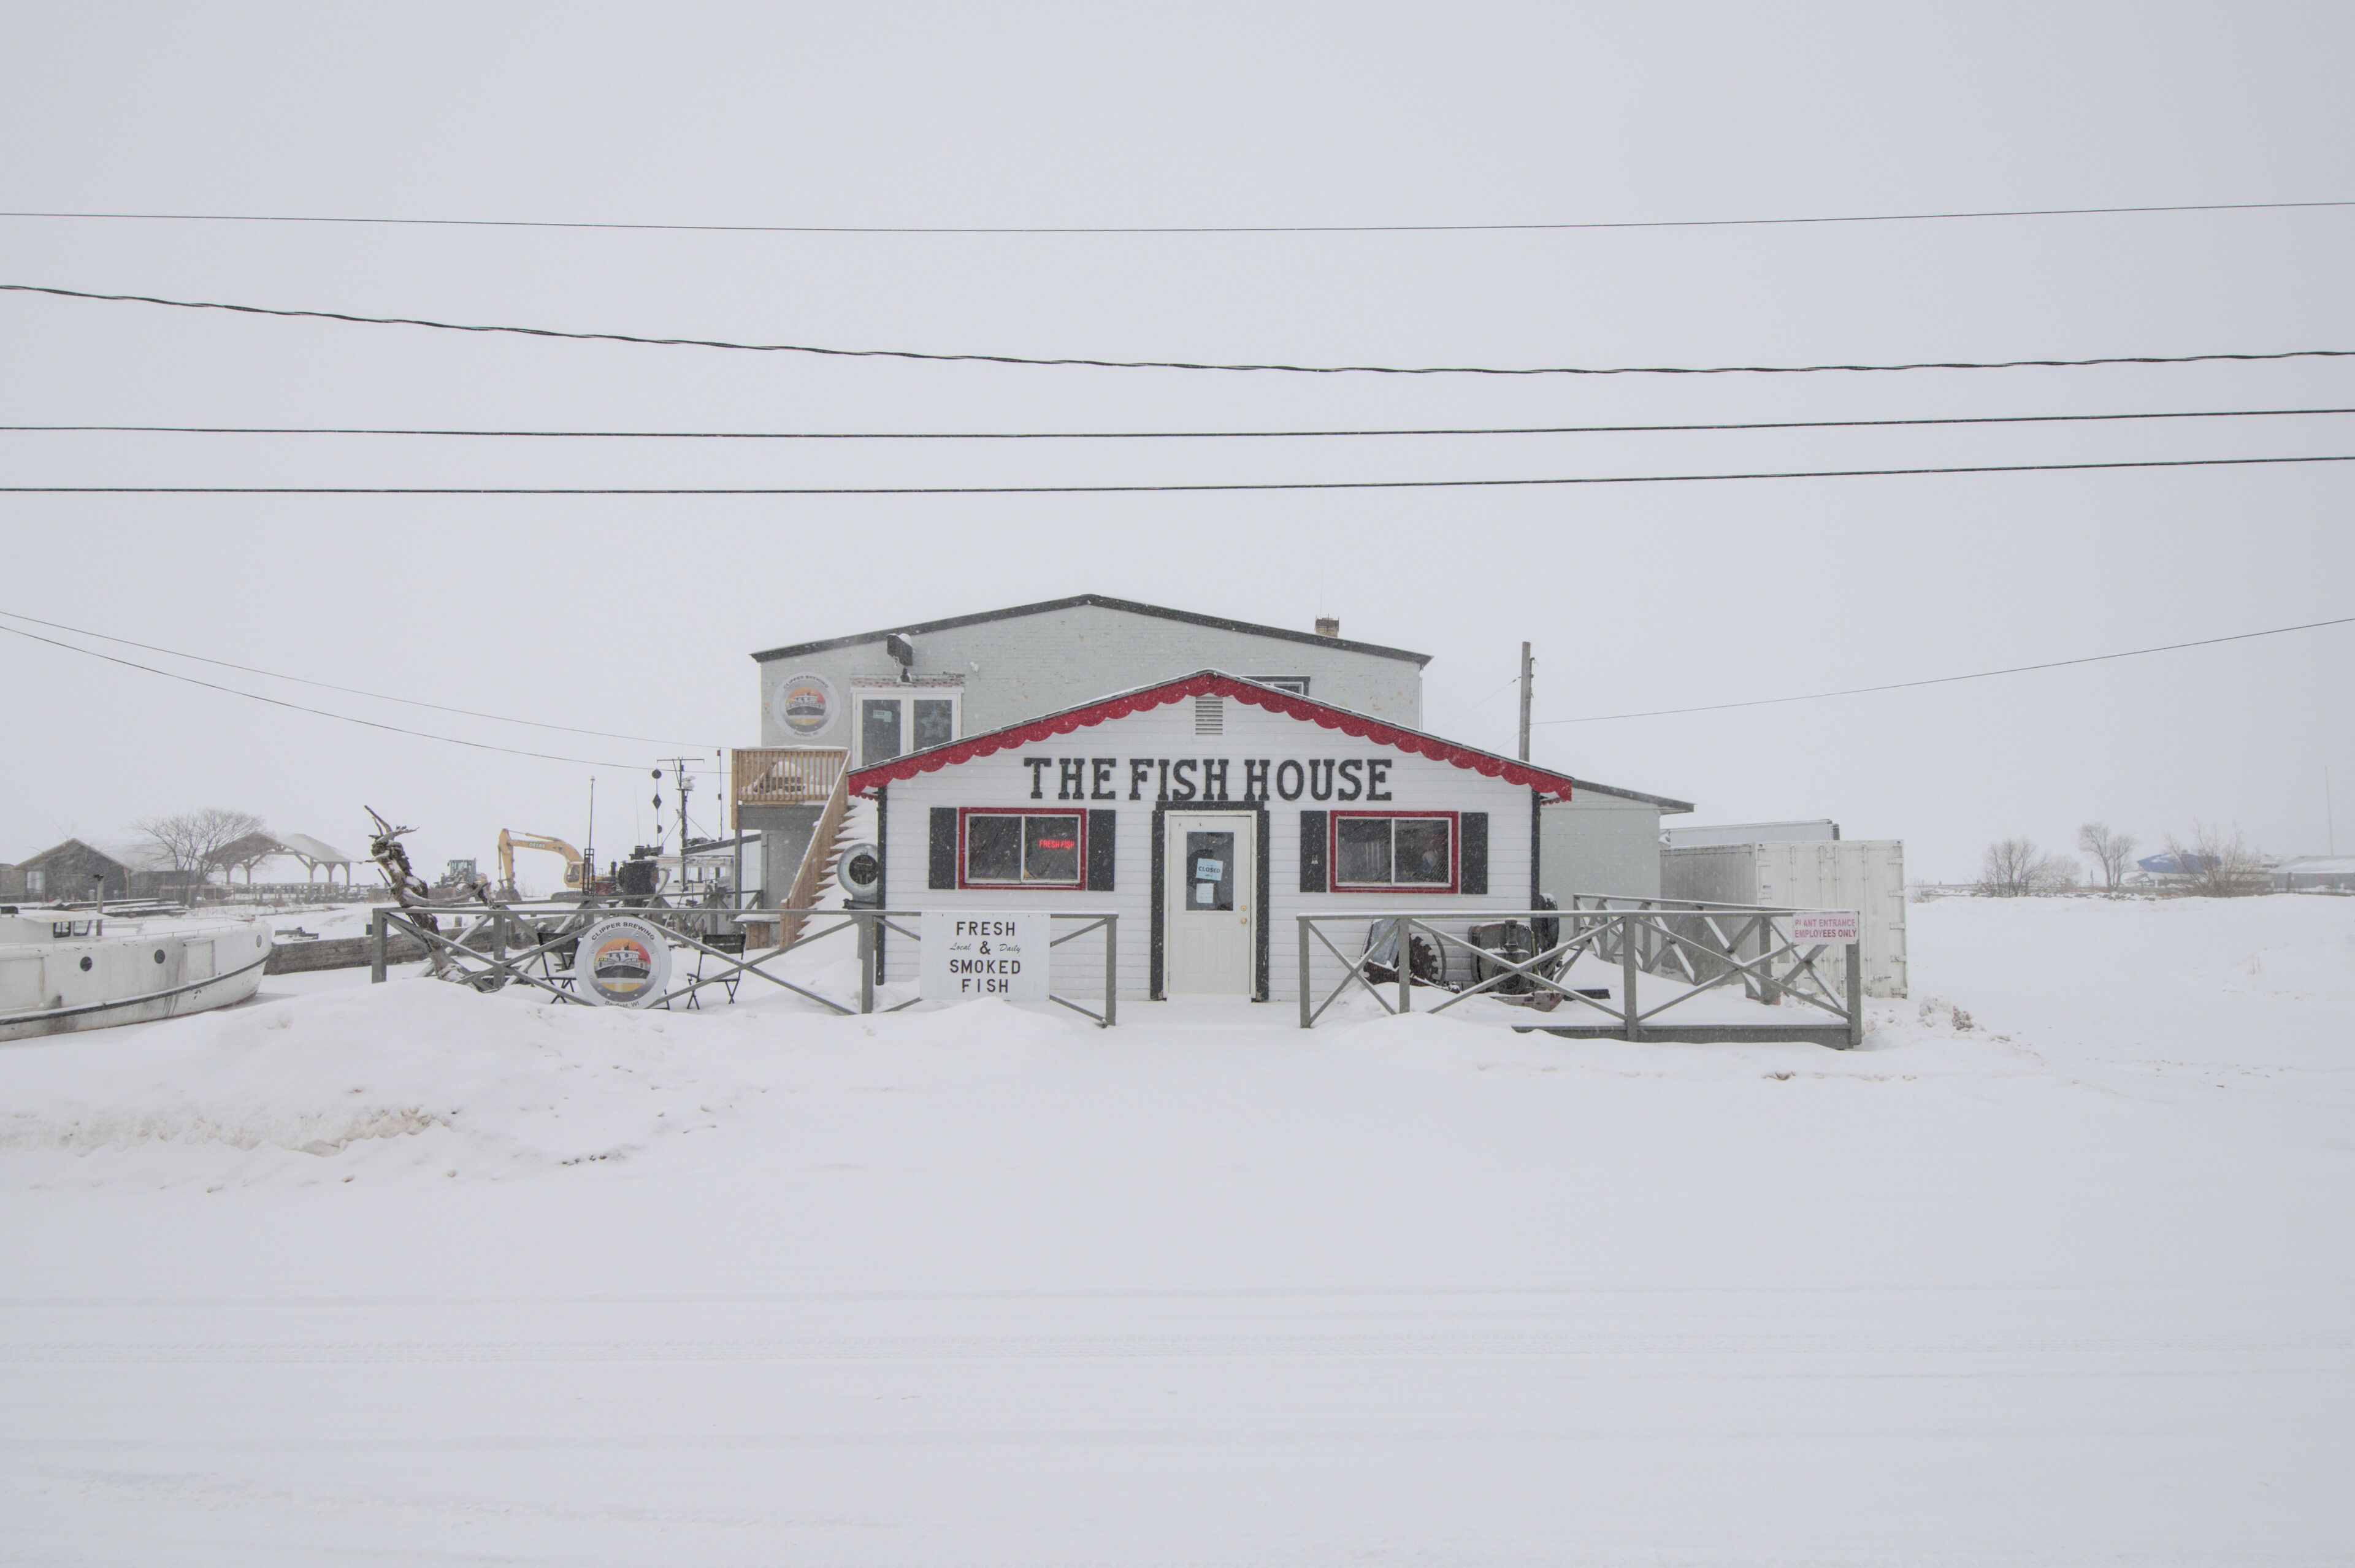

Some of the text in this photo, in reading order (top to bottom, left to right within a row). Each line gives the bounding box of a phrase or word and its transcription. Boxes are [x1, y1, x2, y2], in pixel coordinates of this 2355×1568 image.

[1024, 757, 1393, 801] THE FISH HOUSE
[1039, 838, 1060, 849] FRESH
[955, 921, 1016, 936] FRESH
[1818, 919, 1855, 927] ENTRANCE
[591, 922, 654, 940] CLIPPER BREWING
[1794, 929, 1857, 938] EMPLOYEES ONLY
[949, 940, 1021, 955] Local & Daily
[949, 959, 1021, 974] SMOKED
[961, 979, 1009, 993] FISH
